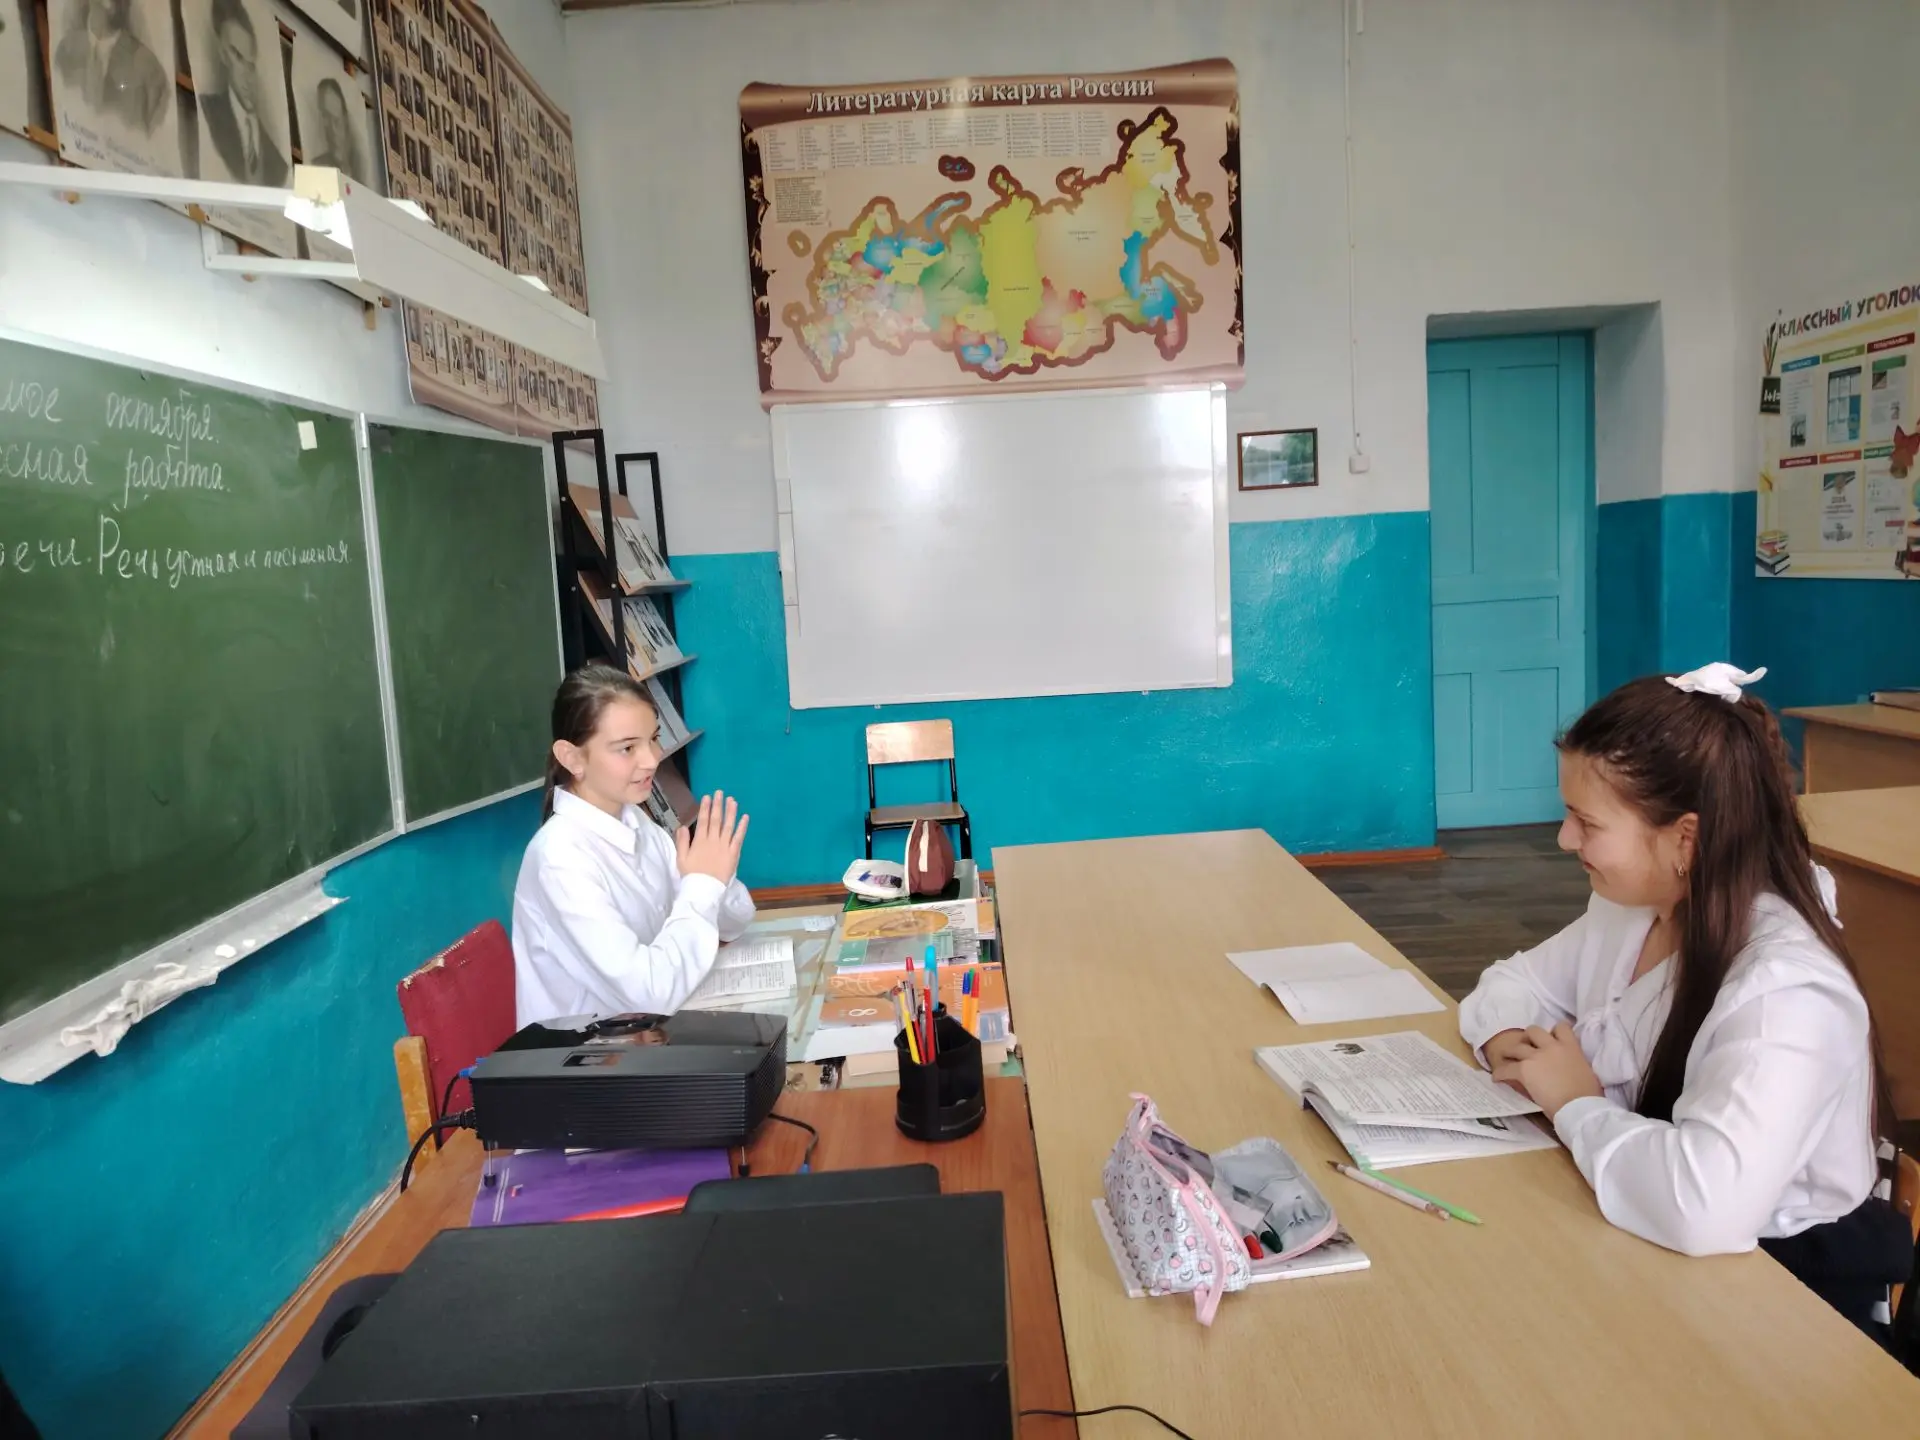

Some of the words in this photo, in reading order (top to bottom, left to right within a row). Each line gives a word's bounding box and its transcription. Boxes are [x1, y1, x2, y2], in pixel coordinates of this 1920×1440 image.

[806, 84, 986, 113] Литературная
[992, 80, 1063, 108] карта
[1067, 76, 1155, 99] России
[1778, 300, 1852, 339] КЛАССНЫЙ
[1857, 284, 1920, 318] УГОЛОК
[0, 442, 94, 486] сная
